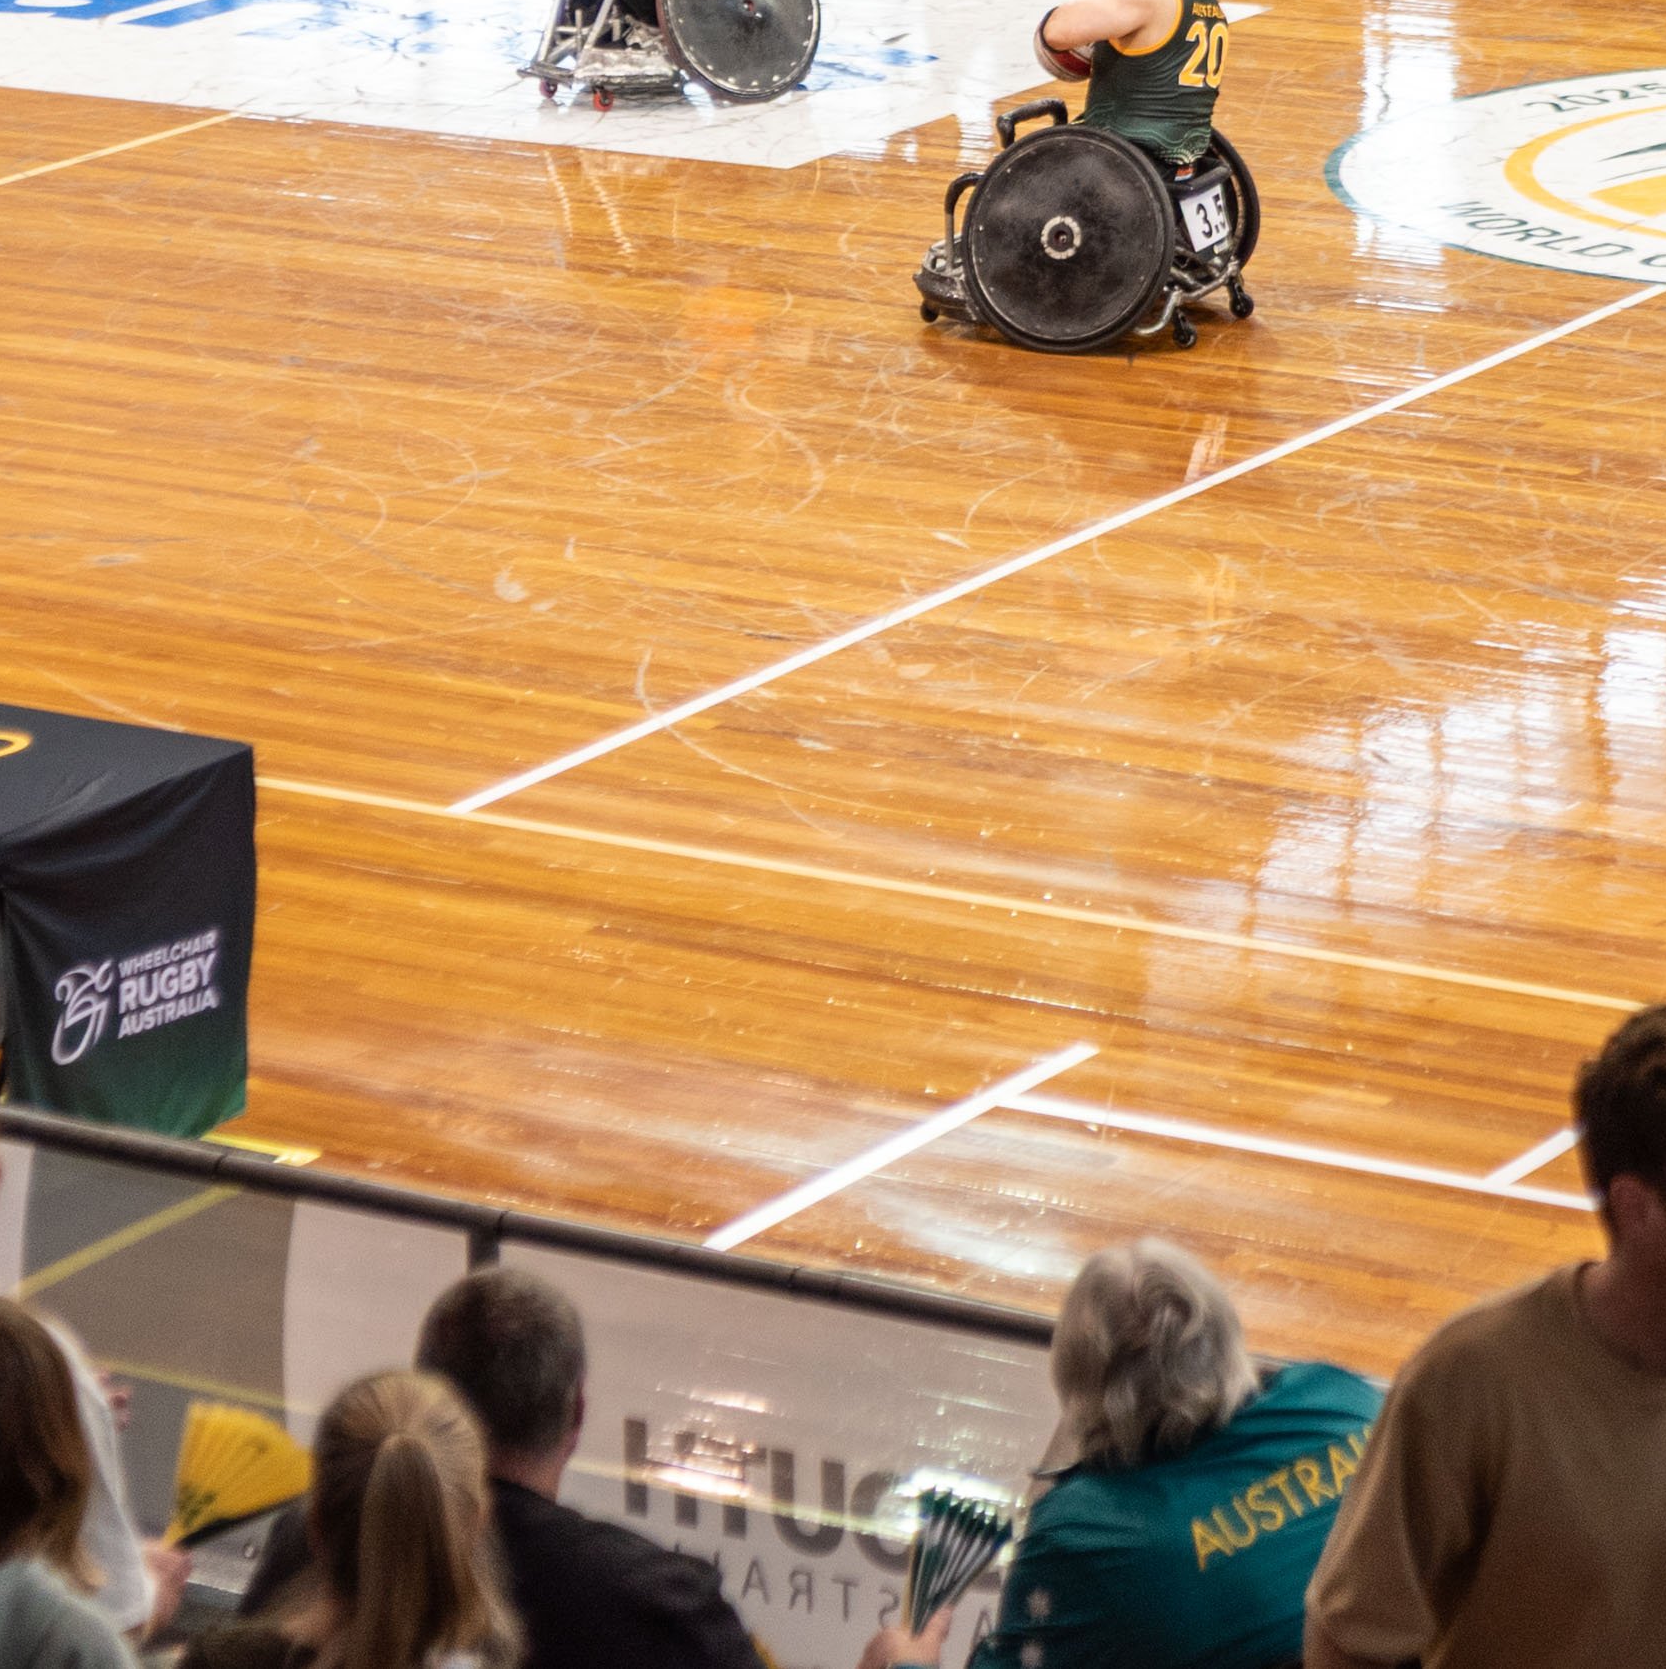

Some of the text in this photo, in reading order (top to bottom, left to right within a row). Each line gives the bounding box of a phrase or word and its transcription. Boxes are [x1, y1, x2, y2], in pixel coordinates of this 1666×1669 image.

[1178, 20, 1230, 89] 20
[1437, 199, 1634, 259] WORLD
[118, 929, 221, 979] WHEELCHAIR
[118, 950, 218, 1017] RUGBY
[118, 986, 220, 1040] AUSTRALIA
[1191, 1424, 1373, 1572] AUSTRA
